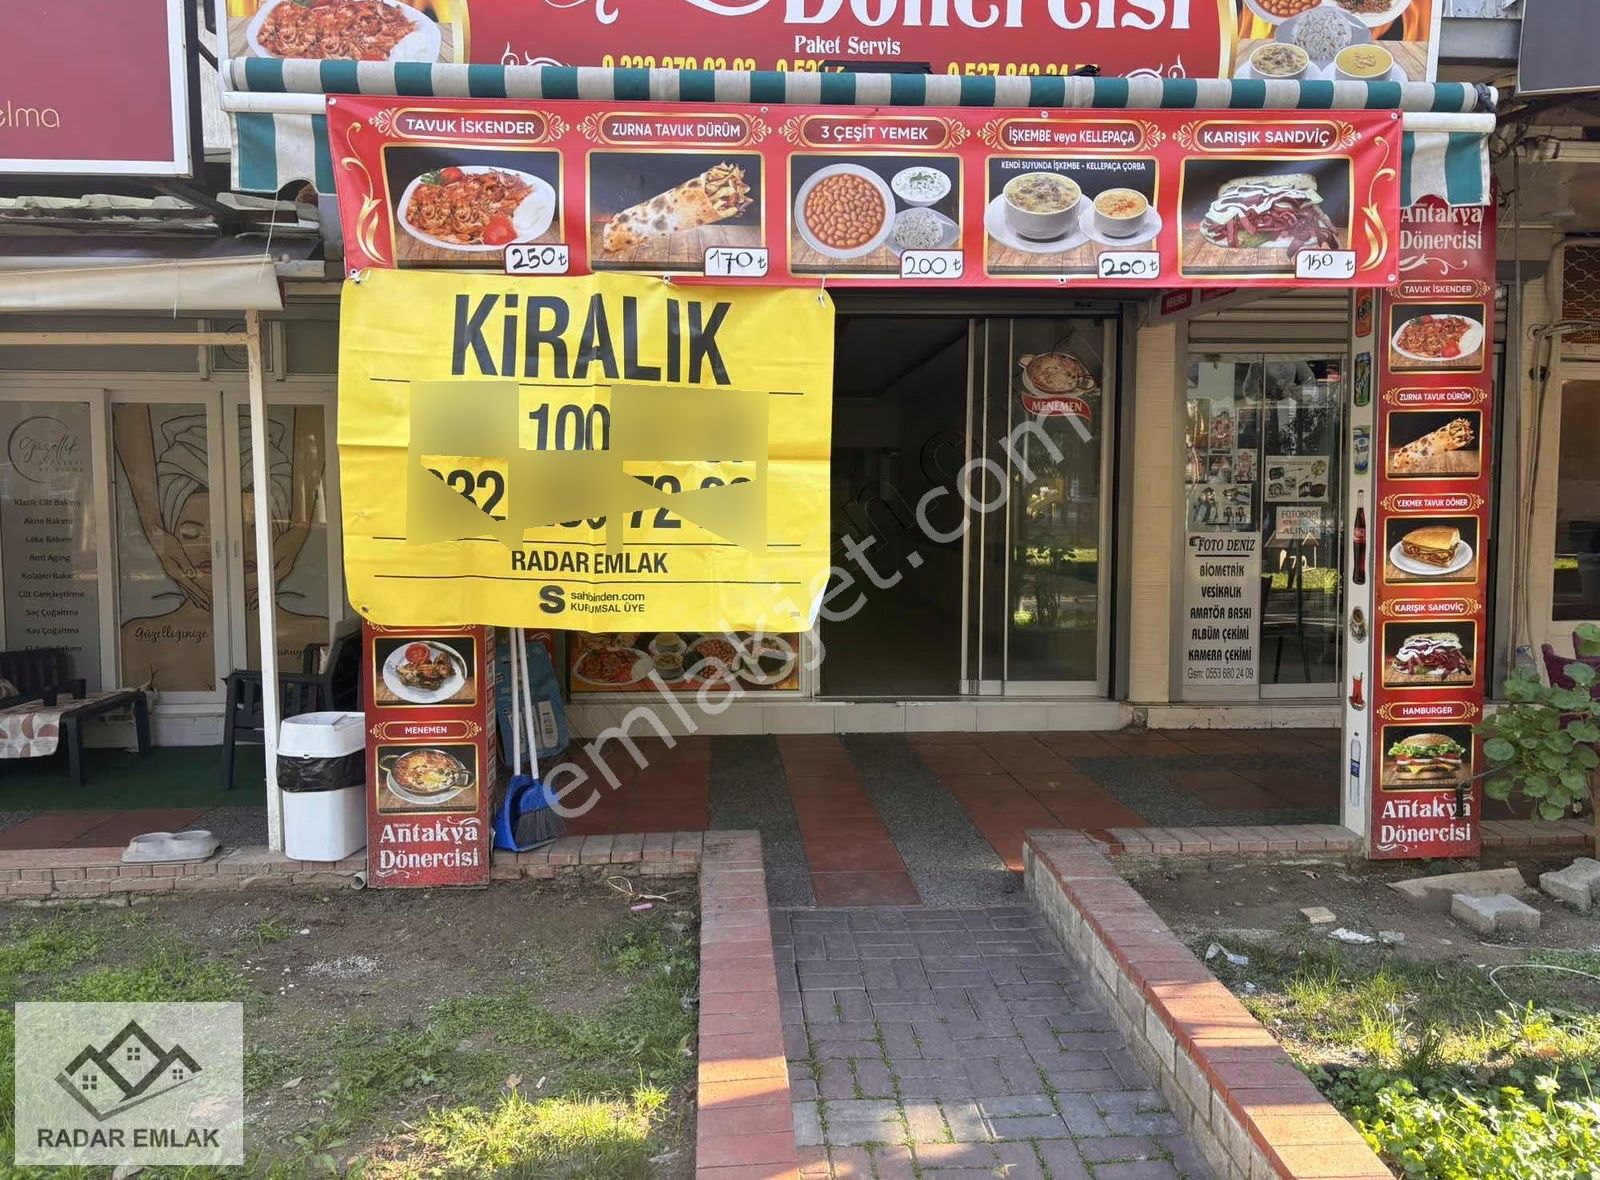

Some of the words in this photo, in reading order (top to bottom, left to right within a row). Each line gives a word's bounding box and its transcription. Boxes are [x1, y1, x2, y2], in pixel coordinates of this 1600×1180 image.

[795, 35, 841, 54] Paket
[848, 35, 902, 56] Servis
[0, 100, 61, 128] lma
[405, 118, 457, 133] TAVUK
[460, 115, 537, 135] İSKENDER
[612, 122, 653, 137] ZURNA
[655, 123, 697, 137] TAVUK
[698, 121, 742, 138] DÜRÜM
[820, 125, 830, 139] 3
[832, 123, 876, 144] ÇEŞİT
[880, 127, 928, 141] YEMEK
[1008, 128, 1053, 147] İŞKEMBE
[1054, 134, 1079, 147] veya
[1080, 131, 1136, 149] KELLEPAÇA
[1203, 130, 1262, 147] KARIŞIK
[1266, 129, 1332, 147] SANDVİÇ
[1000, 158, 1020, 170] KENDİ
[1021, 159, 1052, 171] SUYUNDA
[1052, 158, 1080, 173] İŞKEMBE
[1086, 160, 1122, 173] KELLEPAÇA
[1123, 160, 1146, 173] ÇORBA
[1399, 202, 1483, 227] Antakya
[1399, 230, 1482, 250] Dönercisi
[511, 249, 555, 271] 250
[904, 256, 948, 275] 200
[1404, 285, 1431, 294] TAVUK
[1432, 283, 1473, 294] İSKENDER
[1400, 393, 1423, 401] ZURNA
[1424, 392, 1446, 401] TAVUK
[1447, 390, 1472, 401] DÜRÜM
[1031, 400, 1083, 412] MENEMEN
[1424, 499, 1446, 507] TAVUK
[1446, 496, 1470, 507] DÖNER
[1197, 538, 1225, 552] FOTO
[1227, 536, 1257, 552] DENİZ
[511, 550, 590, 573] RADAR
[594, 552, 669, 575] EMLAK
[1199, 562, 1246, 577] BİOMETRİK
[1201, 584, 1243, 599] VESİKALIK
[624, 602, 646, 613] ÜYE
[1190, 604, 1226, 620] AMATÖR
[1228, 607, 1253, 620] BASKI
[1395, 604, 1426, 613] KARIŞIK
[1428, 601, 1464, 613] SANDVİÇ
[1191, 625, 1221, 640] ALBÜM
[1222, 624, 1250, 643] ÇEKİMİ
[1188, 648, 1223, 661] KAMERA
[1224, 645, 1252, 664] ÇEKİMİ
[1205, 667, 1222, 679] 0553
[1236, 667, 1244, 679] 24
[1402, 706, 1453, 716] HAMBURGER
[405, 726, 448, 735] MENEMEN
[379, 820, 480, 845] Antakya
[1381, 823, 1471, 844] Dönercisi
[379, 847, 480, 869] Dönercisi
